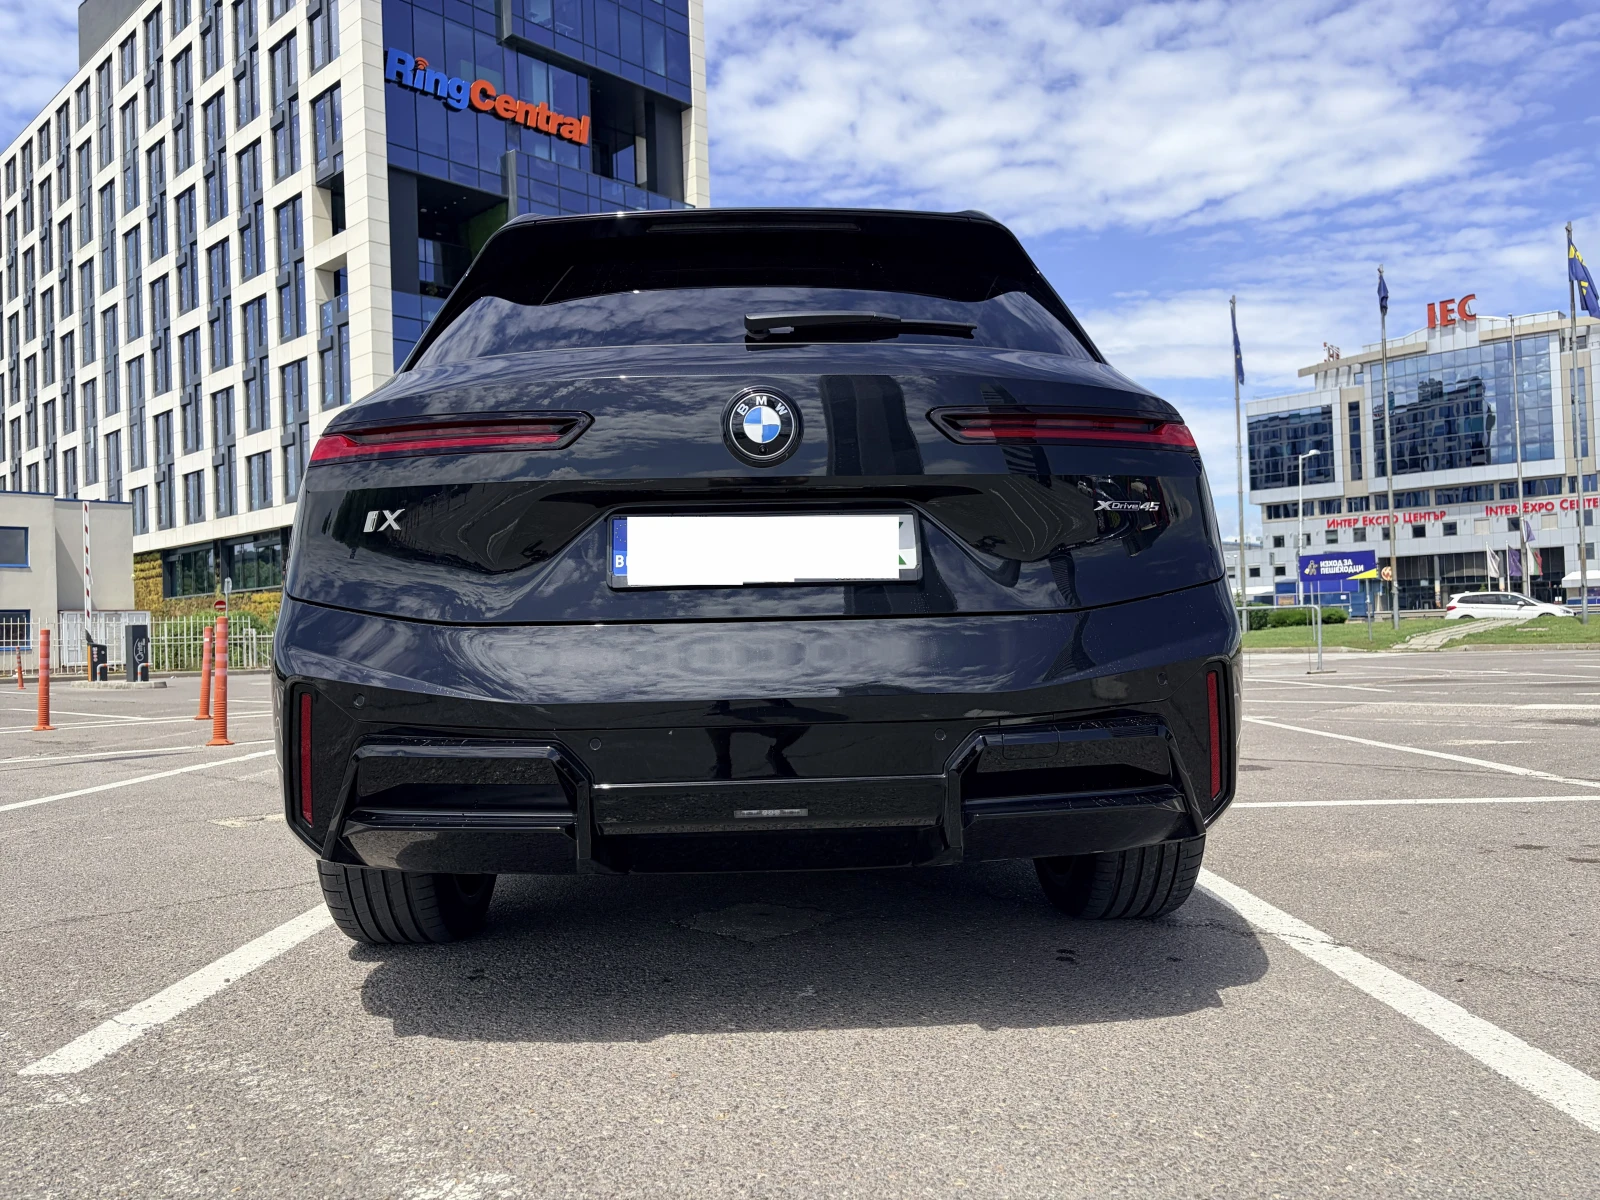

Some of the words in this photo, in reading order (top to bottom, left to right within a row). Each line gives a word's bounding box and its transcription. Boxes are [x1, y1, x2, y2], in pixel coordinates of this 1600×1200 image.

[385, 47, 590, 145] RingCentral
[1427, 293, 1477, 329] IEC
[737, 396, 789, 416] BMW
[1485, 505, 1518, 516] INTER
[1523, 501, 1555, 513] EXPO
[1560, 497, 1600, 511] CETE
[1327, 518, 1359, 529] ИНТЕР
[1403, 510, 1446, 524] ЦЕНТЪР
[615, 554, 628, 568] B
[1320, 559, 1343, 568] ИЗХОД
[1343, 558, 1353, 566] ЗА
[1320, 565, 1364, 574] ПЕШЕХОДЦИ
